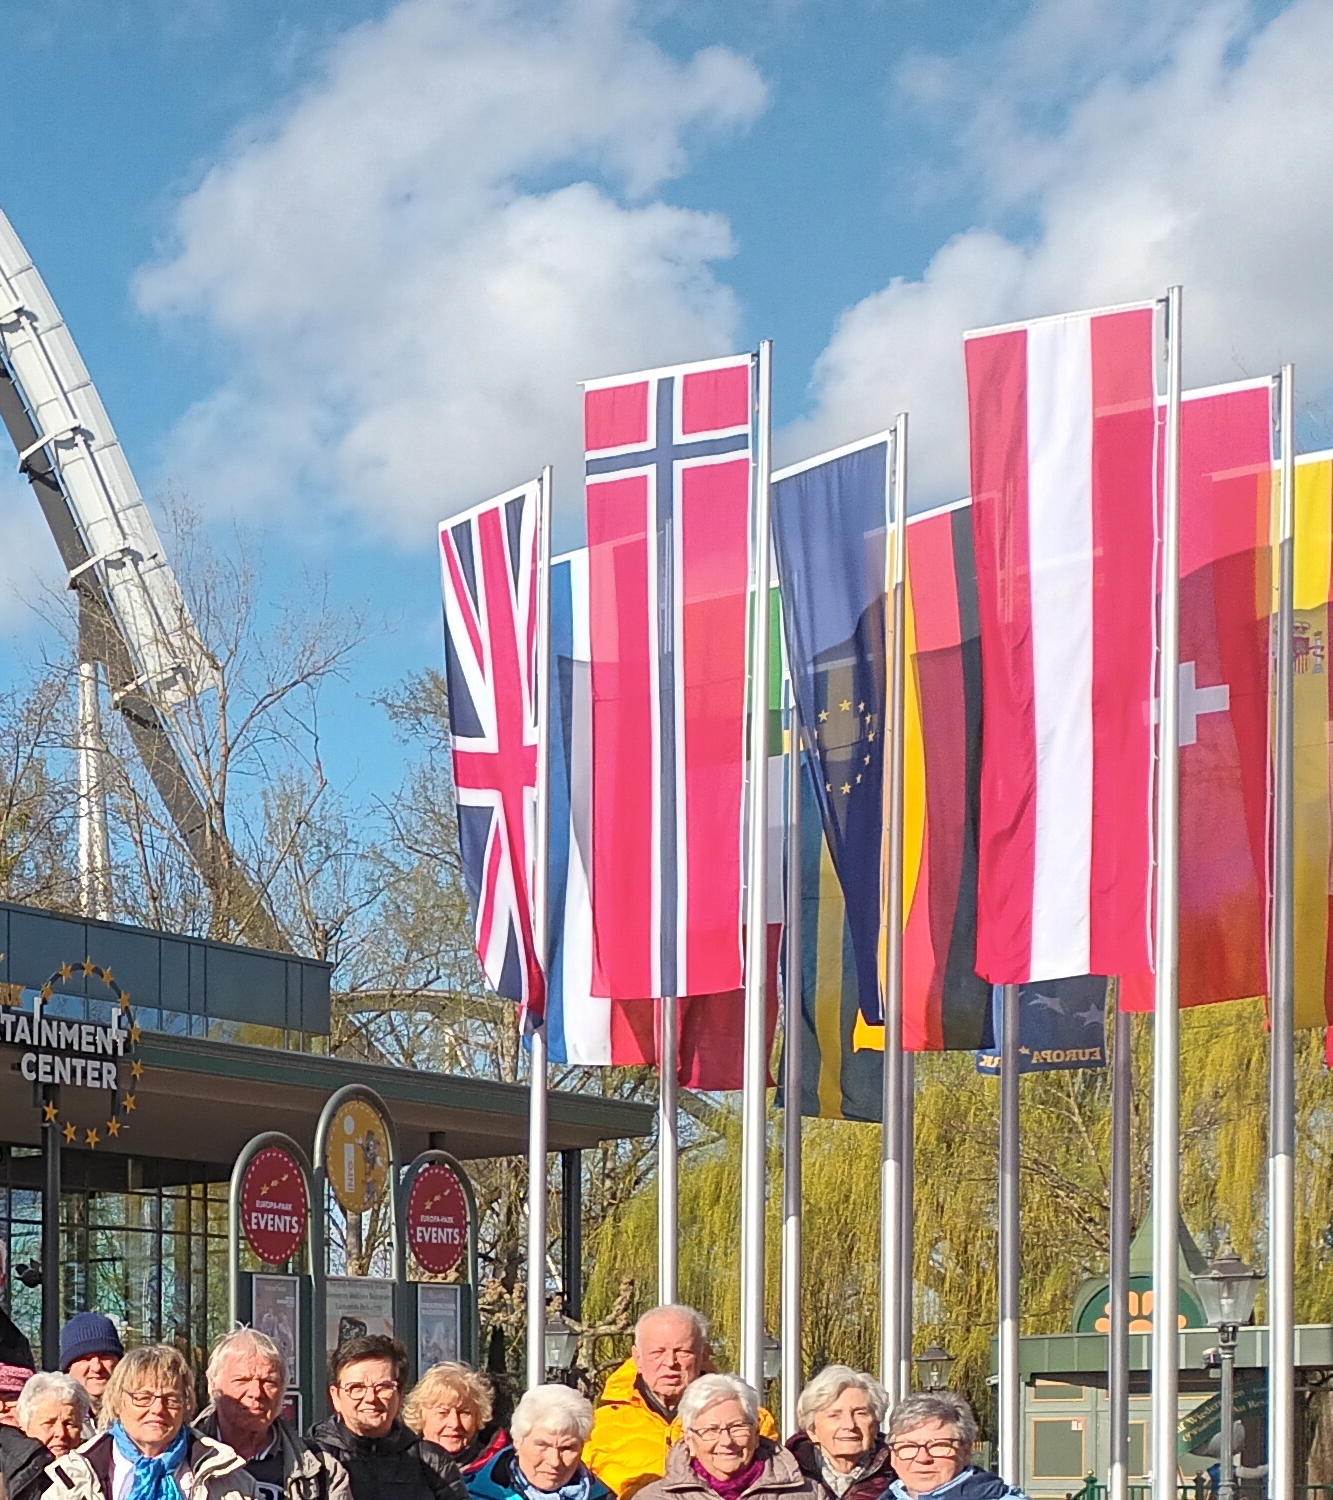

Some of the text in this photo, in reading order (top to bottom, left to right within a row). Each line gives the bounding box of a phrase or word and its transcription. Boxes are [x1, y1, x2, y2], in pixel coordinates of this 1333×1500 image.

[20, 1052, 118, 1090] CENTER
[251, 1212, 299, 1234] EVENTS
[416, 1226, 460, 1245] EVENTS
